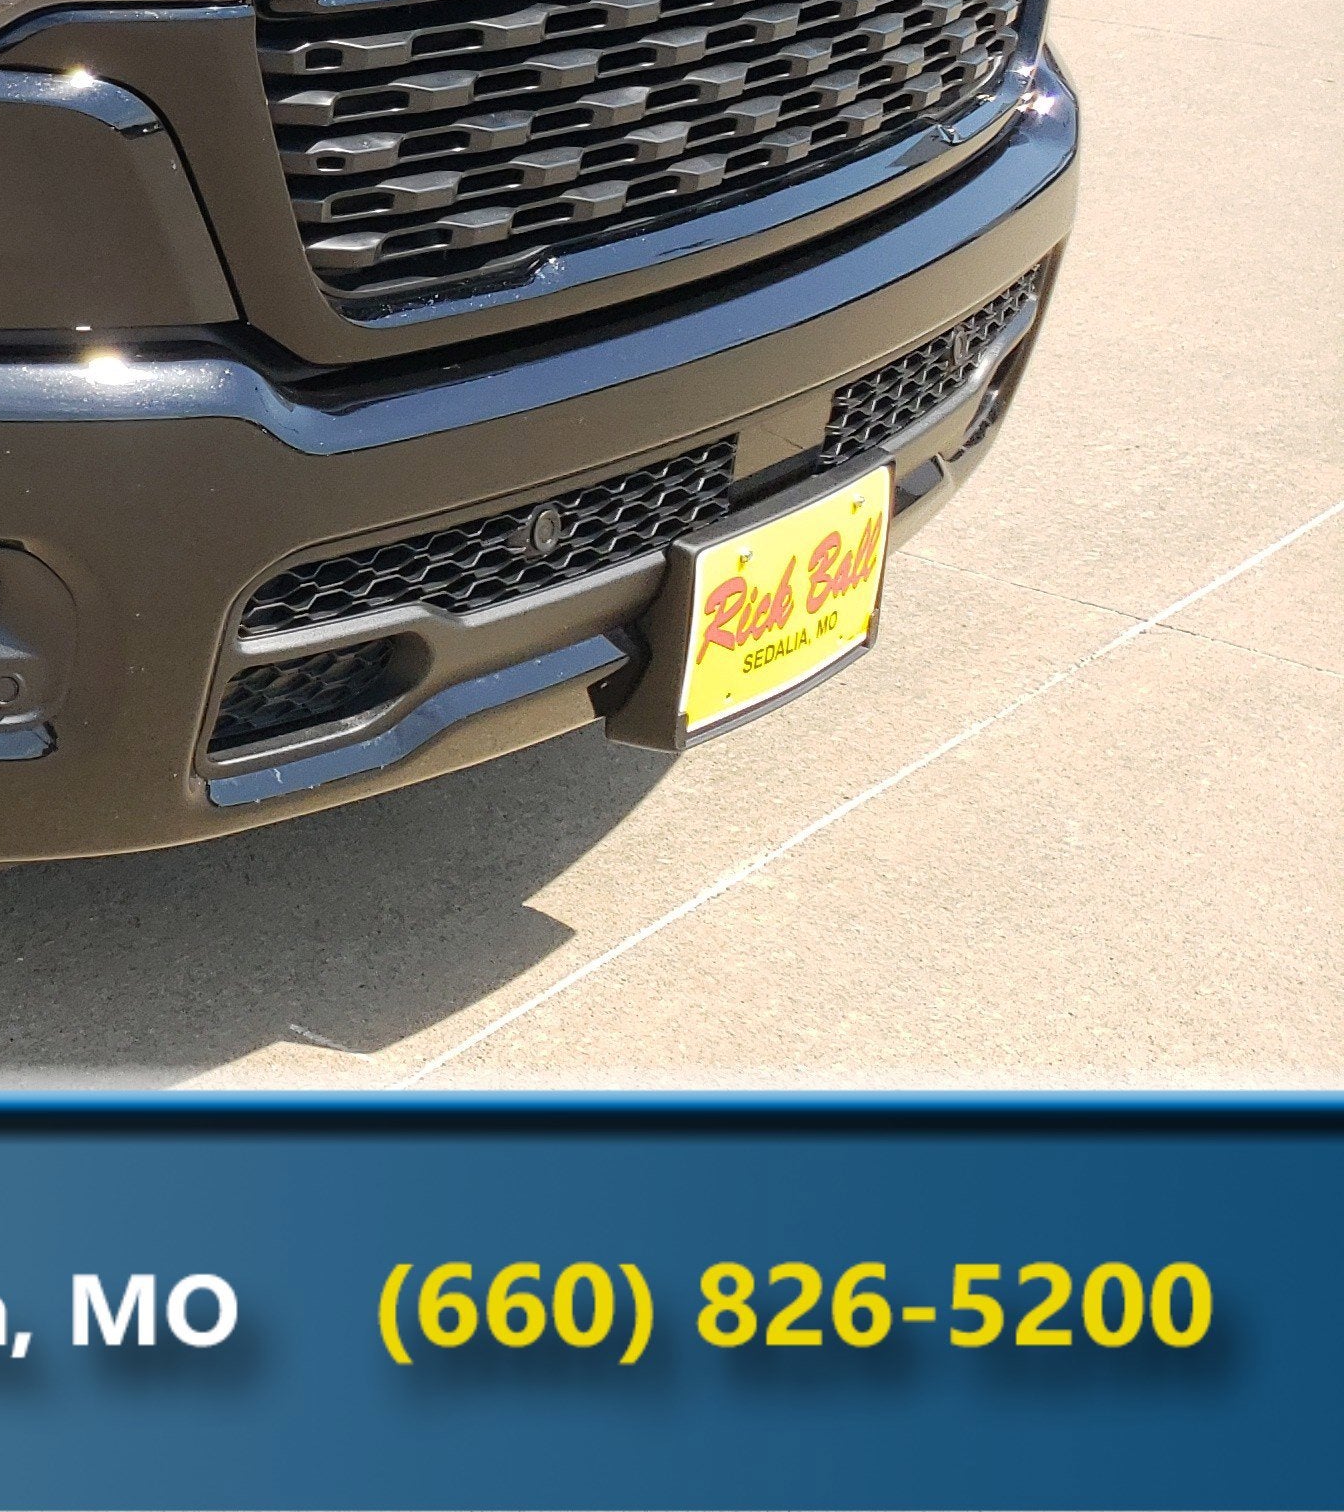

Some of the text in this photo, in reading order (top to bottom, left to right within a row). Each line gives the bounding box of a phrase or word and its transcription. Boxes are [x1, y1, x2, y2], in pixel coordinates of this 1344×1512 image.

[696, 510, 883, 665] Rick Ball
[742, 609, 839, 675] SEDALIA, MO
